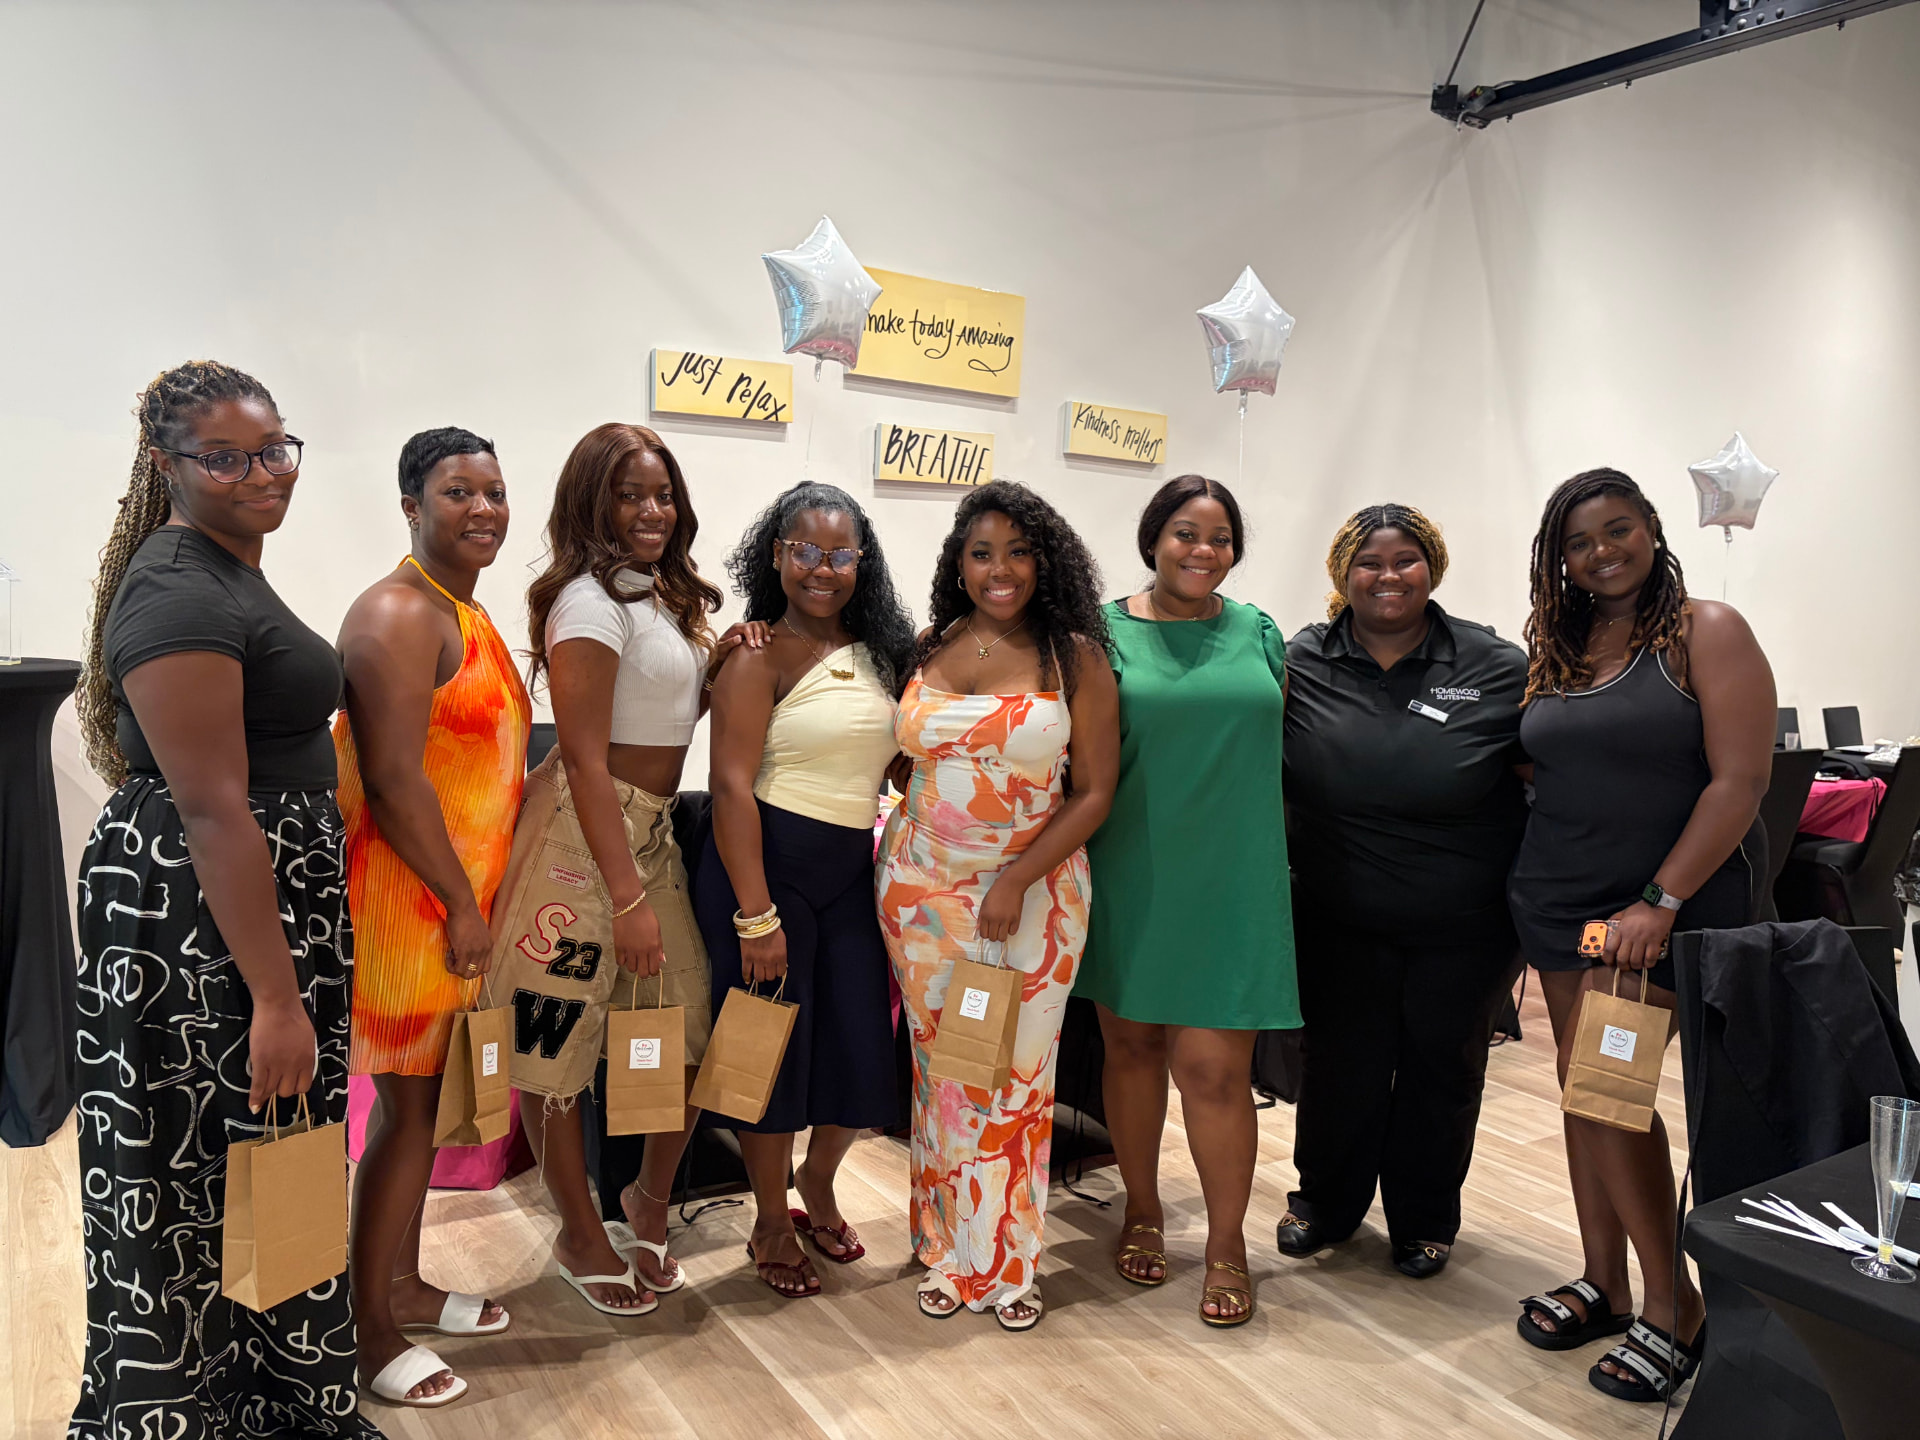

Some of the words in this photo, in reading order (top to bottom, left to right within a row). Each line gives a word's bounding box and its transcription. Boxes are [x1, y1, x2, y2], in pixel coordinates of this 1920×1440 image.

[908, 308, 955, 360] today
[726, 372, 787, 422] relax
[884, 424, 991, 486] BREATHE
[1430, 687, 1480, 697] HOMEWOOD
[552, 866, 586, 881] UNFINISHED
[556, 874, 578, 885] LEGACY
[516, 903, 577, 964] S
[546, 937, 601, 981] 23
[512, 988, 586, 1060] W
